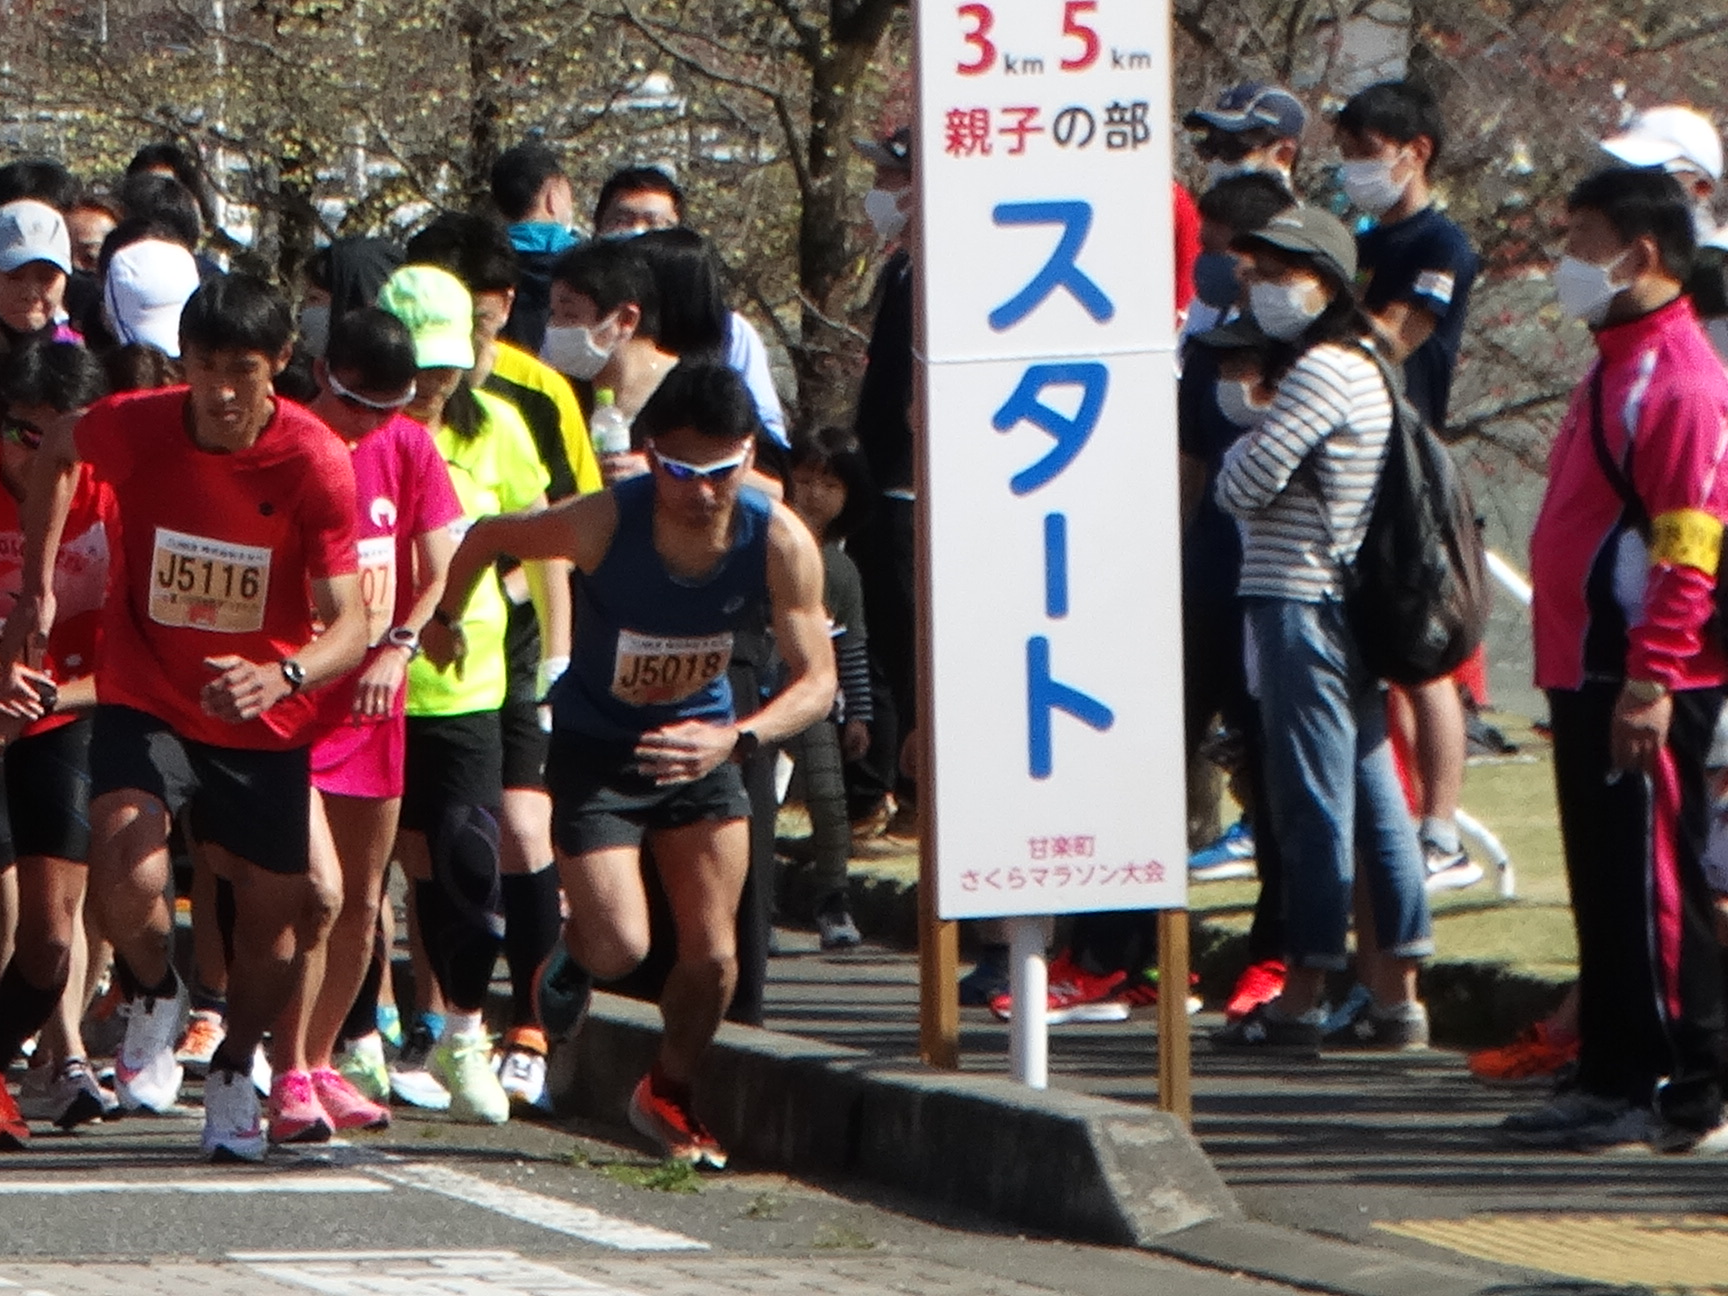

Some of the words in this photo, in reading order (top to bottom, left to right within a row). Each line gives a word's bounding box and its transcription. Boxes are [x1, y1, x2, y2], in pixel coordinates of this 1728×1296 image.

[944, 100, 1151, 158] 親子の部
[987, 200, 1115, 780] スタート
[158, 554, 261, 600] J5116
[620, 651, 722, 687] J5018
[1027, 834, 1096, 860] 甘楽町
[959, 858, 1167, 892] さくらマラソン大会
